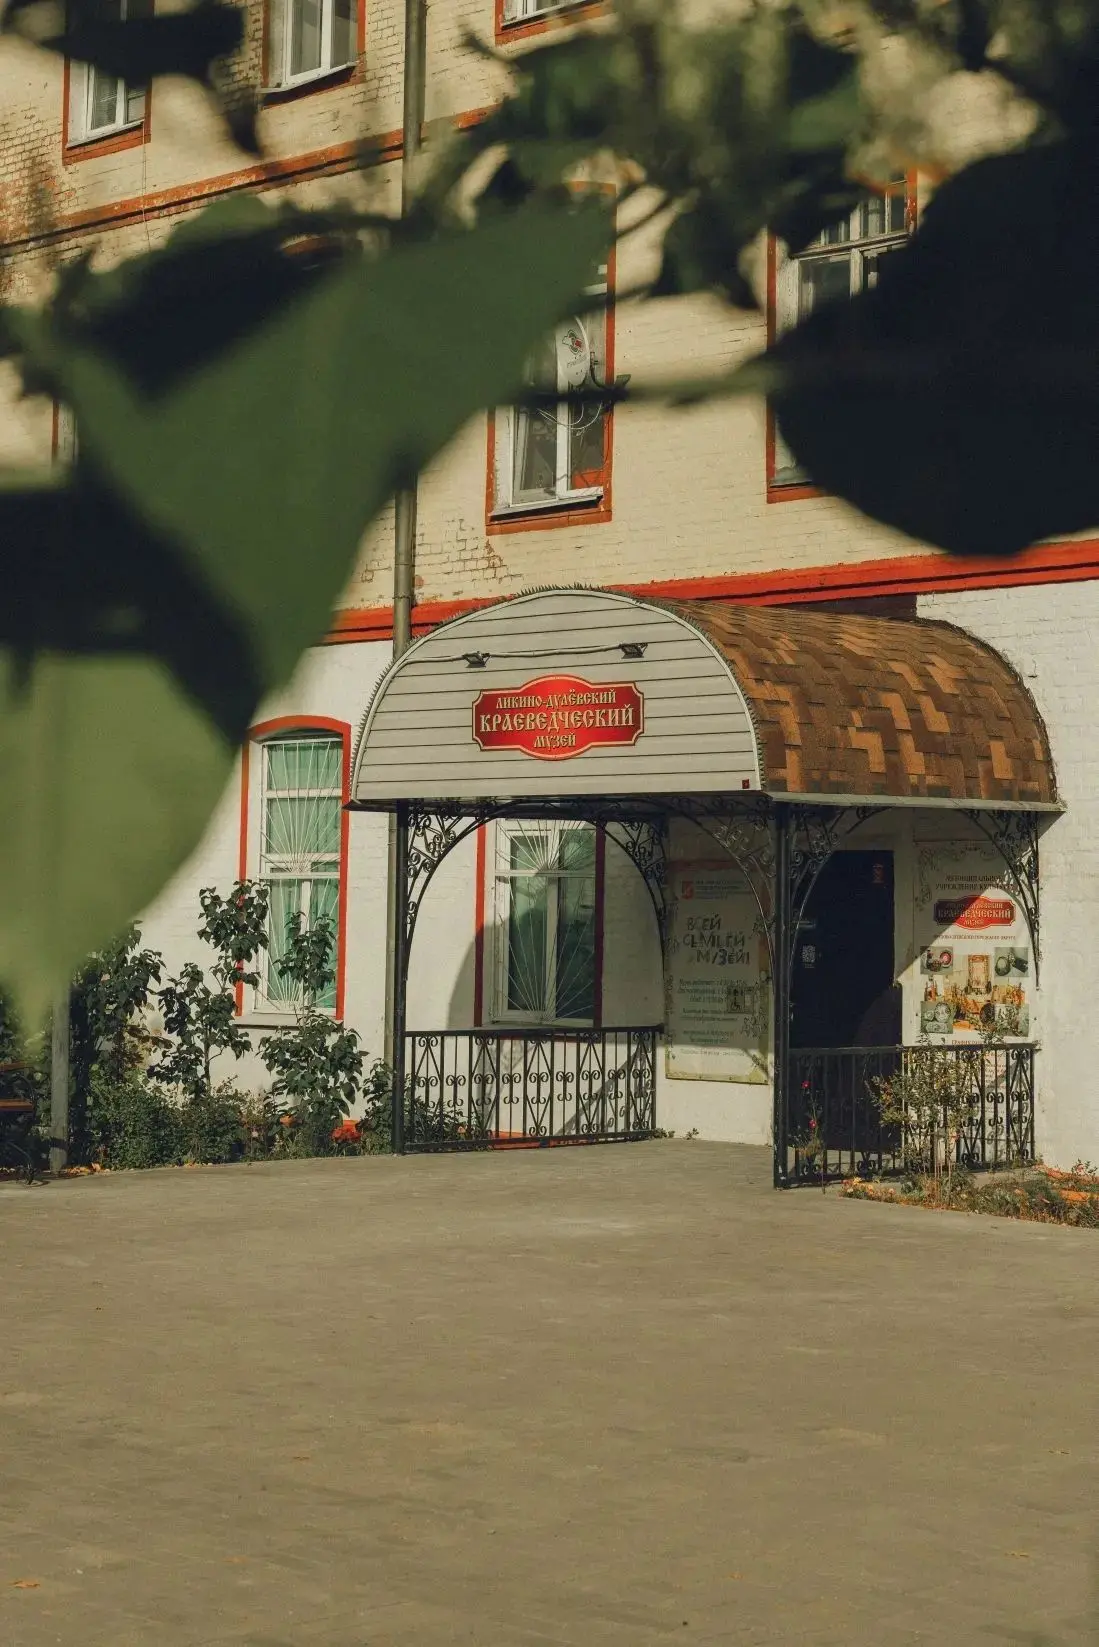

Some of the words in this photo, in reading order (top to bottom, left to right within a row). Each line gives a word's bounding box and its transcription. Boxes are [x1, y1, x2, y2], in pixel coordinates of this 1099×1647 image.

[495, 689, 617, 709] ЛИКИНО-ДУЛЁВСКИЙ
[479, 703, 635, 733] КРАЕВЕДЧЕСКИЙ
[533, 732, 577, 751] МУЗЕЙ
